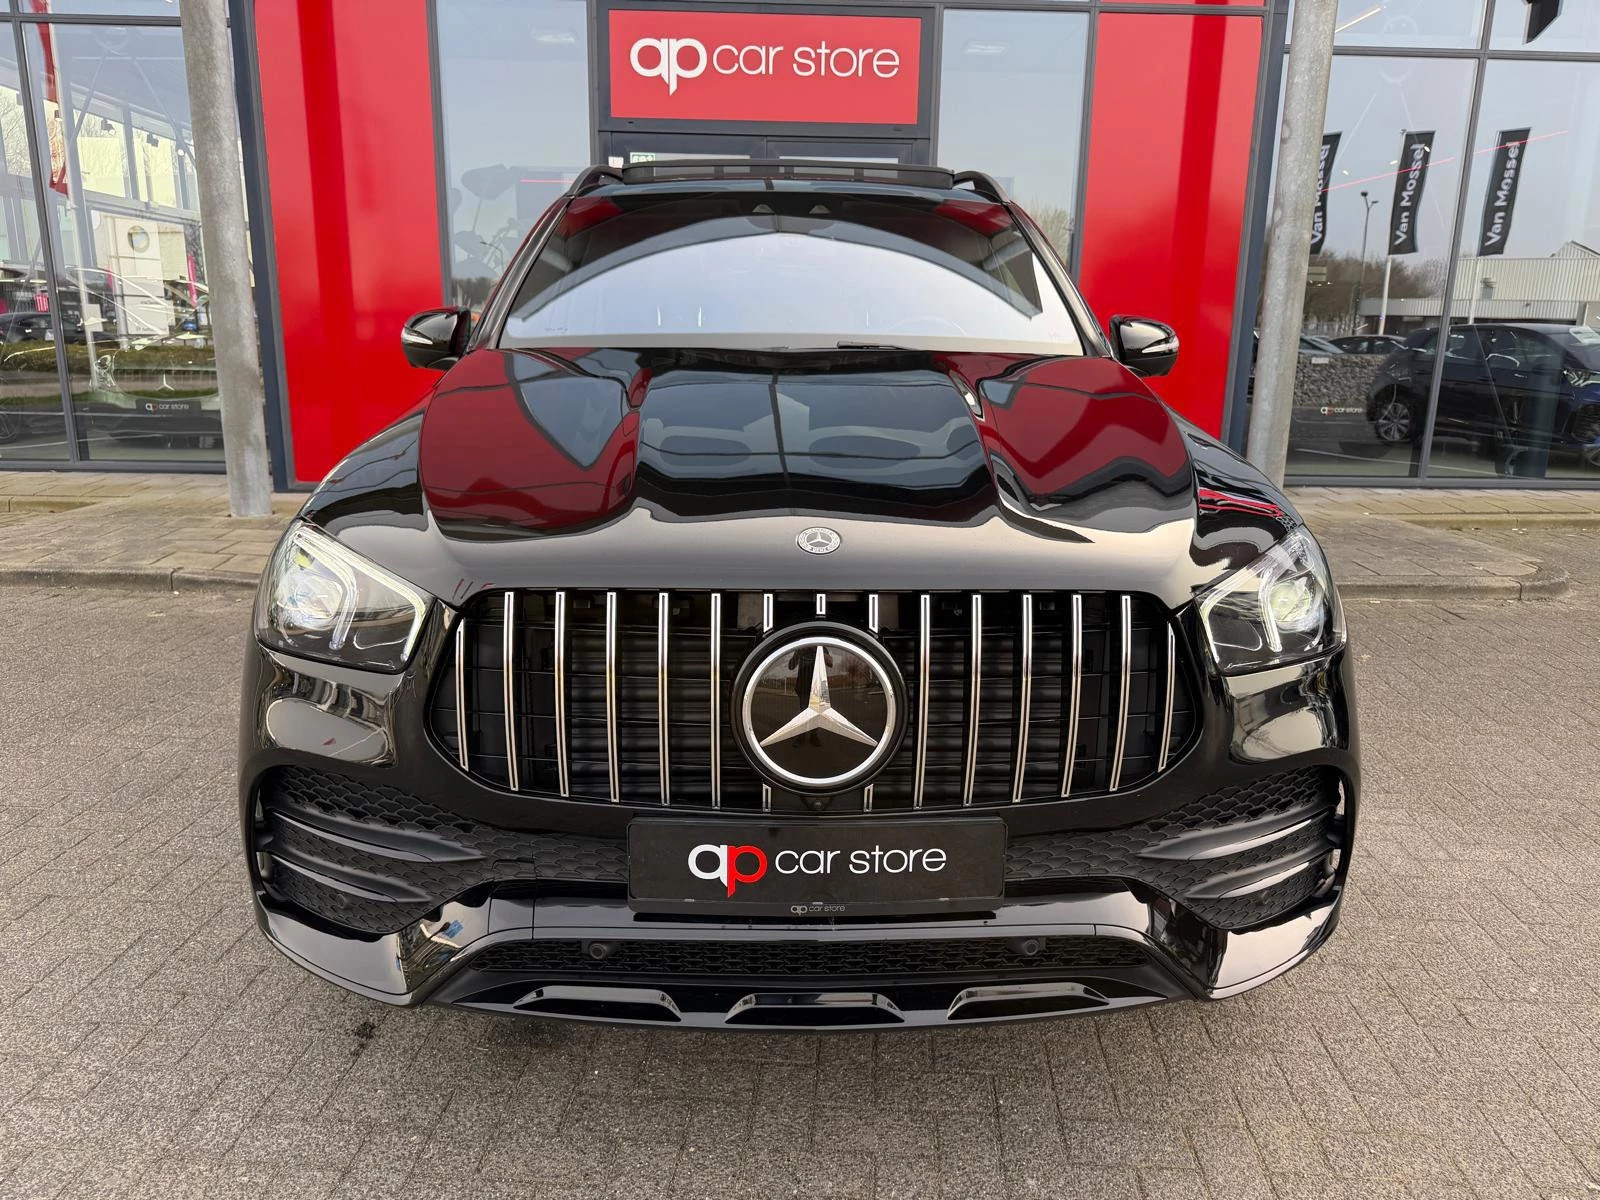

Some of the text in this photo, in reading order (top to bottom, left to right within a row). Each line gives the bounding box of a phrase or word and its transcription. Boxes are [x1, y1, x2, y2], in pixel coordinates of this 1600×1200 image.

[713, 44, 783, 75] car
[792, 41, 900, 78] store
[1394, 143, 1425, 246] Van Mossel
[1485, 141, 1520, 247] Van Mossel
[775, 849, 841, 875] car
[849, 844, 947, 874] store
[824, 903, 846, 912] store
